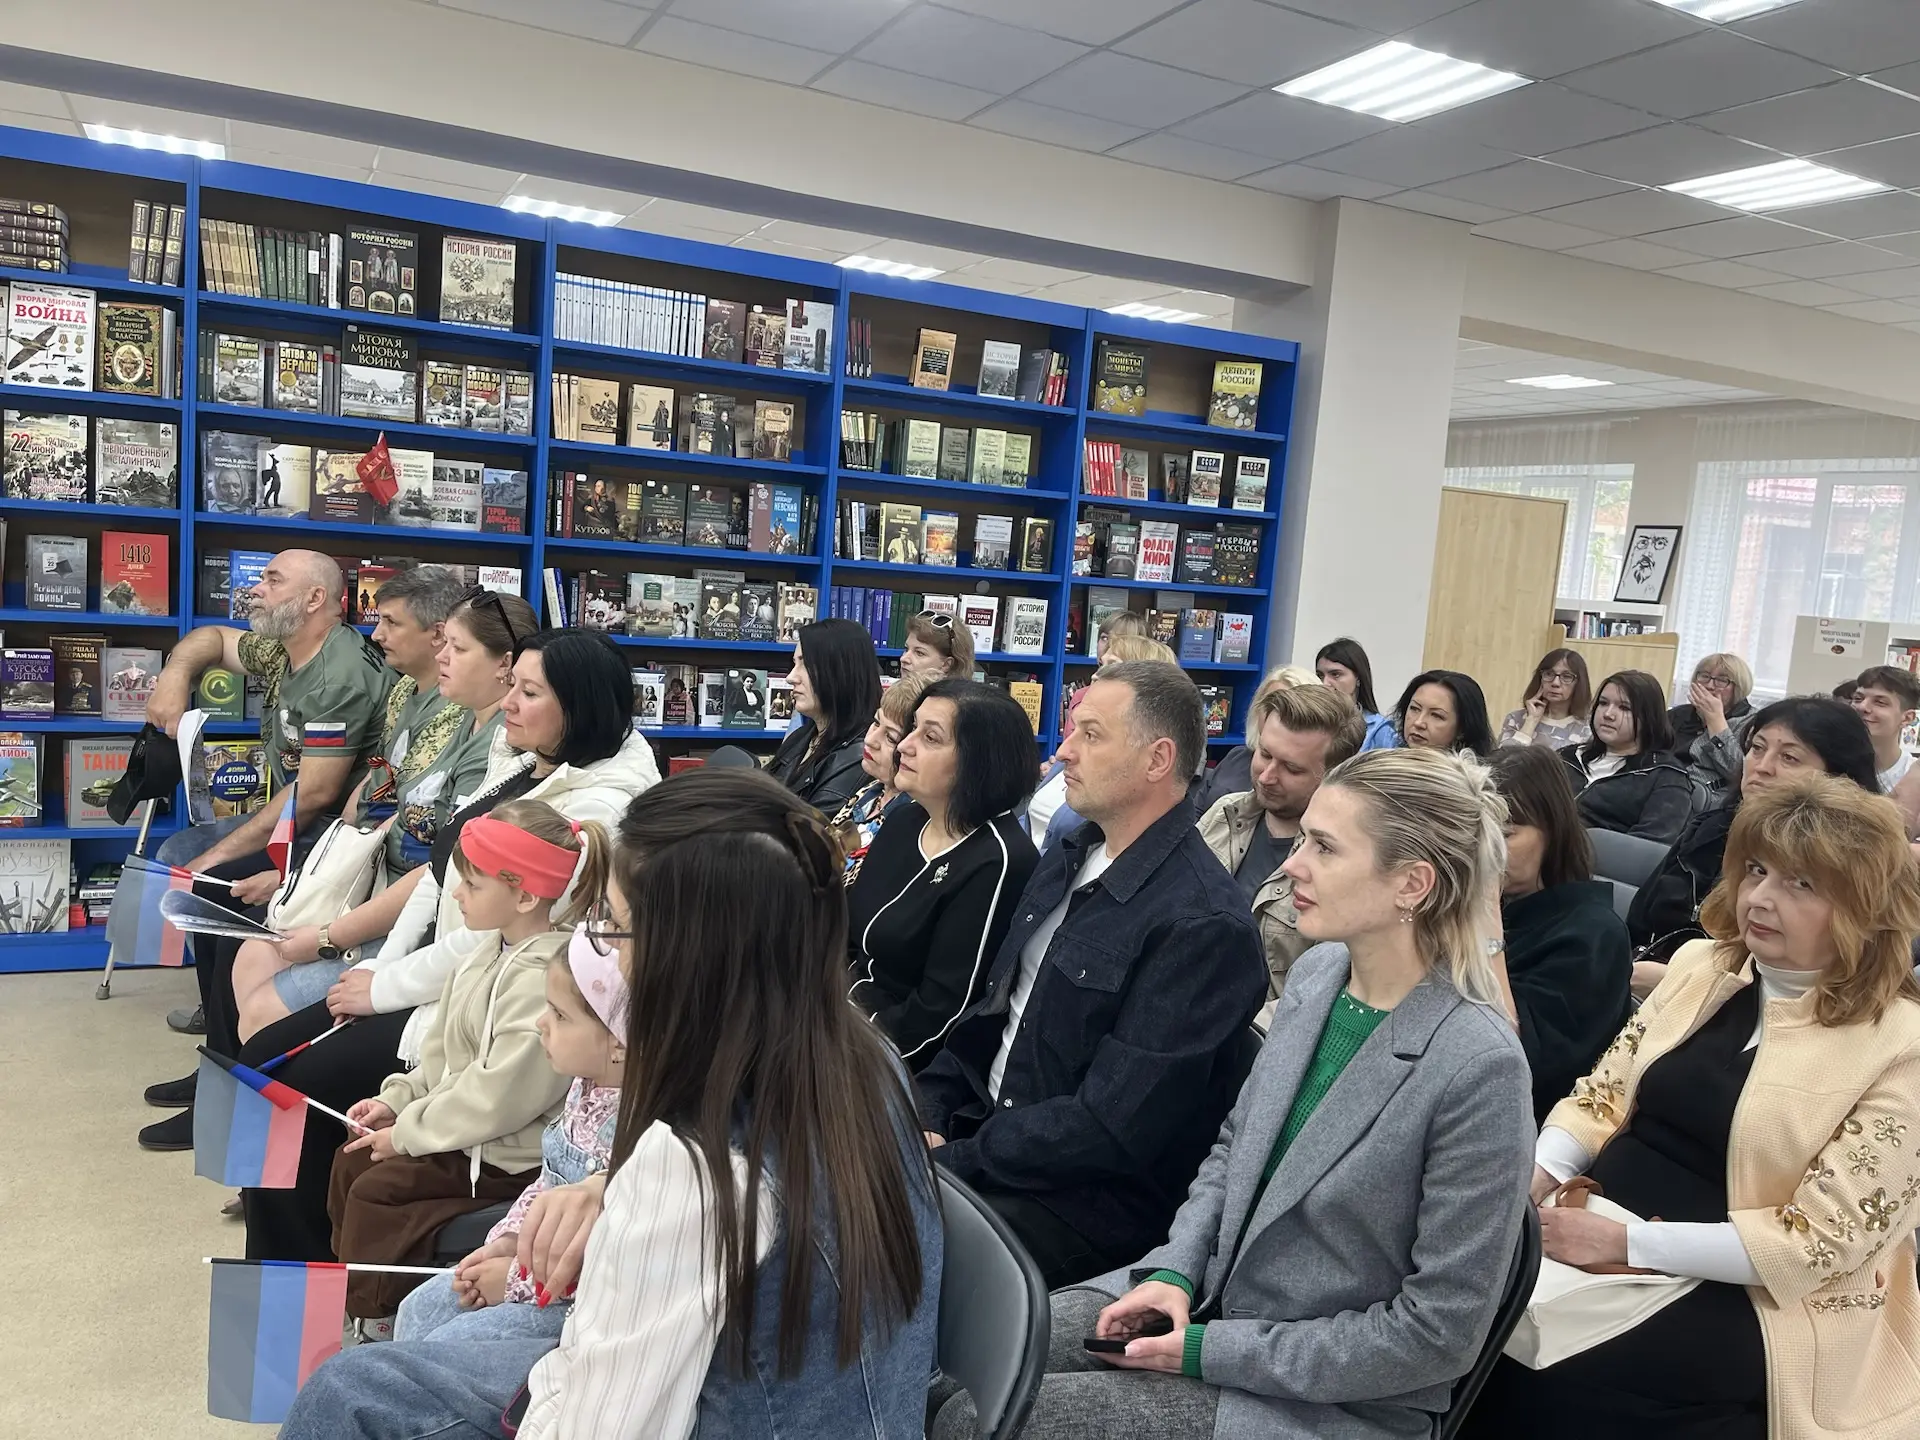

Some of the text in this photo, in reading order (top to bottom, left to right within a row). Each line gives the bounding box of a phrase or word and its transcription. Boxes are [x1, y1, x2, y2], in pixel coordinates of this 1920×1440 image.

[351, 232, 414, 247] ИСТОРИЯ РОССИИ
[446, 241, 512, 260] ИСТОРИЯ РОССИИ
[17, 294, 86, 308] ВТОРАЯ МИРОВАЯ
[15, 302, 87, 324] ВОЙНА
[115, 332, 143, 340] ВЛАСТИ
[358, 333, 402, 348] ВТОРАЯ
[280, 347, 317, 361] БИТВА ЗА
[351, 344, 409, 360] МИРОВАЯ
[280, 358, 317, 373] БЕРЛИН
[359, 355, 402, 368] ВОЙНА
[1109, 355, 1141, 367] МОНЕТЫ
[1113, 364, 1135, 373] МИРА
[1221, 366, 1256, 376] ДЕНЬГИ
[467, 370, 490, 381] БИТВА
[1220, 375, 1255, 385] РОССИИ
[10, 432, 31, 453] 22
[31, 445, 56, 455] ИЮНЯ
[104, 443, 170, 458] НЕПОКОРЕННЫЙ
[112, 456, 161, 469] СТАЛИНГРАД
[1201, 458, 1217, 466] СССР
[1246, 462, 1262, 470] СССР
[628, 483, 642, 494] 100
[774, 503, 797, 512] НЕВСКИЙ
[1143, 538, 1174, 552] ФЛАГИ
[1220, 544, 1252, 553] РОССИИ
[120, 544, 151, 563] 1418
[1143, 552, 1171, 566] МИРА
[482, 574, 519, 585] ПРИЛЕПИН
[1017, 603, 1044, 614] ИСТОРИЯ
[1014, 636, 1041, 646] РОССИИ
[7, 664, 49, 673] КУРСКАЯ
[14, 673, 43, 681] БИТВА
[82, 754, 128, 770] ТАНК
[216, 774, 257, 784] ИСТОРИЯ
